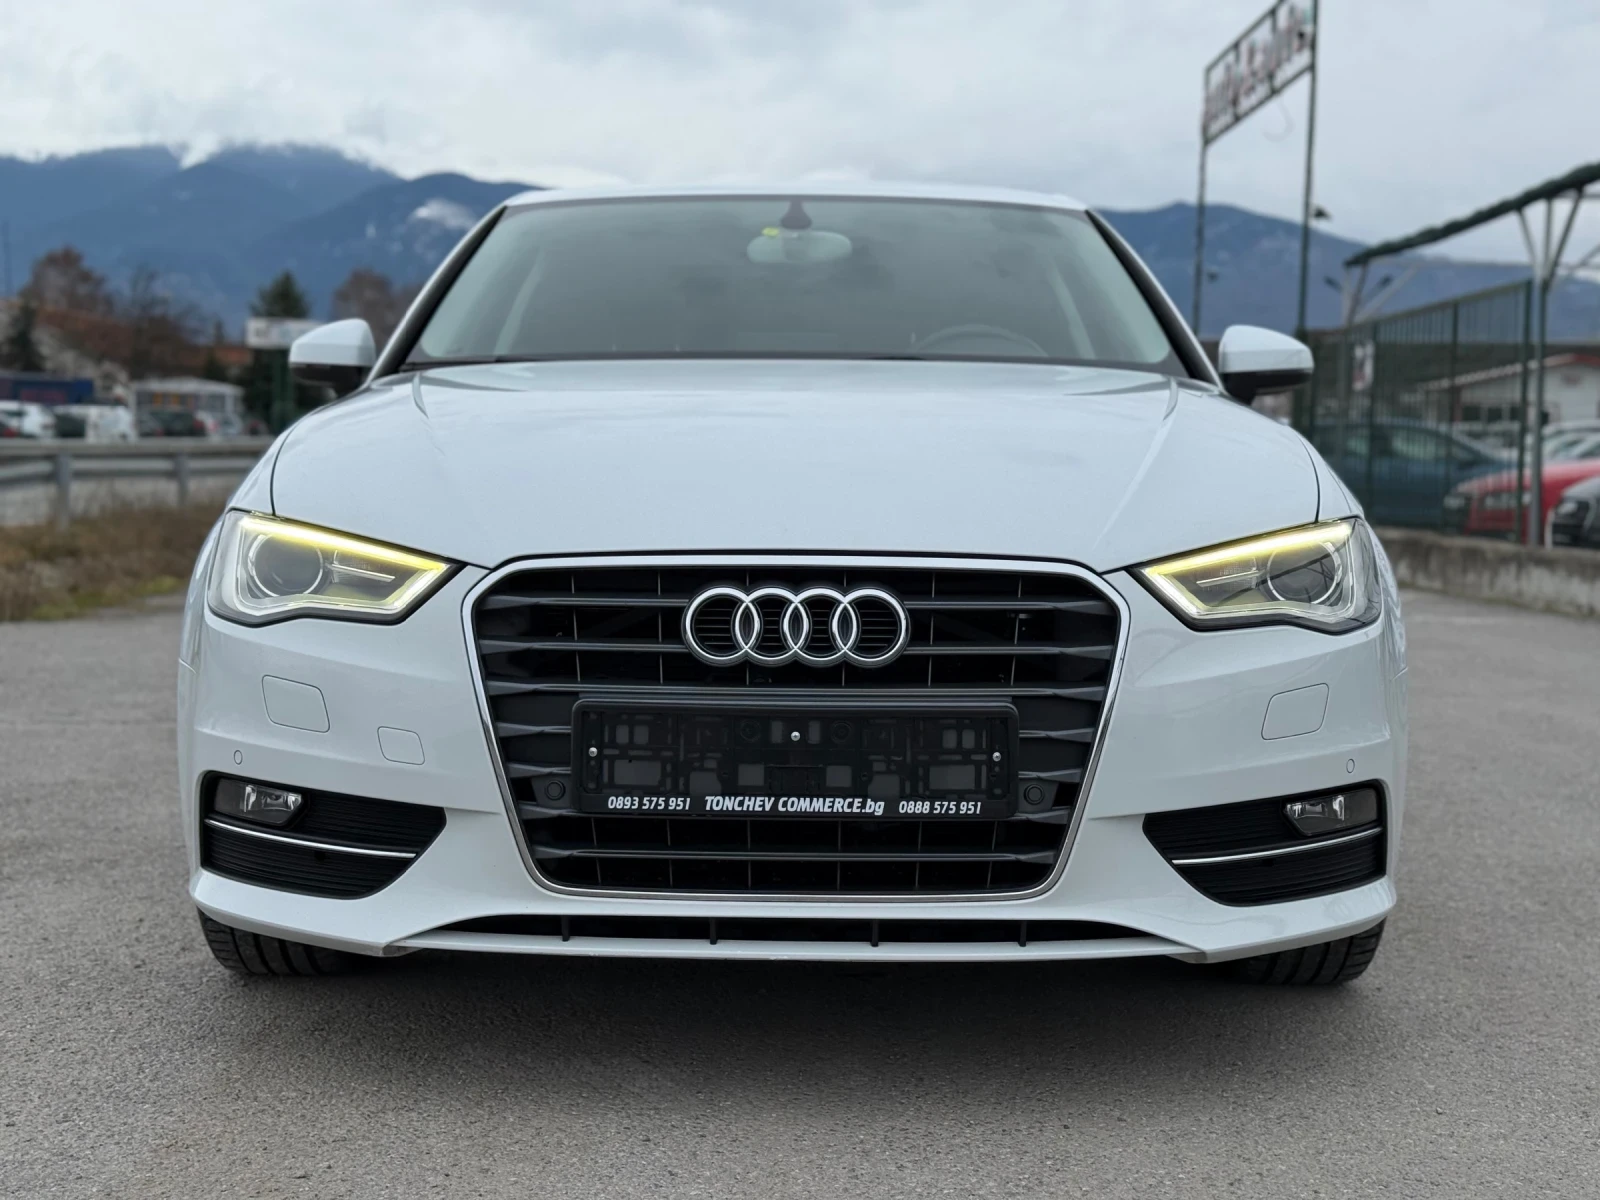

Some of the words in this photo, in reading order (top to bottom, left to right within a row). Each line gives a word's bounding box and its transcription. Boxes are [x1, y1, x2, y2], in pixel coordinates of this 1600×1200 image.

[607, 795, 640, 810] 0893
[641, 796, 666, 810] 575
[668, 797, 692, 811] 951
[704, 795, 776, 813] TONCHEV
[777, 796, 886, 816] COMMERCE.bg
[898, 800, 931, 815] 0888
[933, 801, 957, 815] 575
[959, 801, 983, 816] 951
